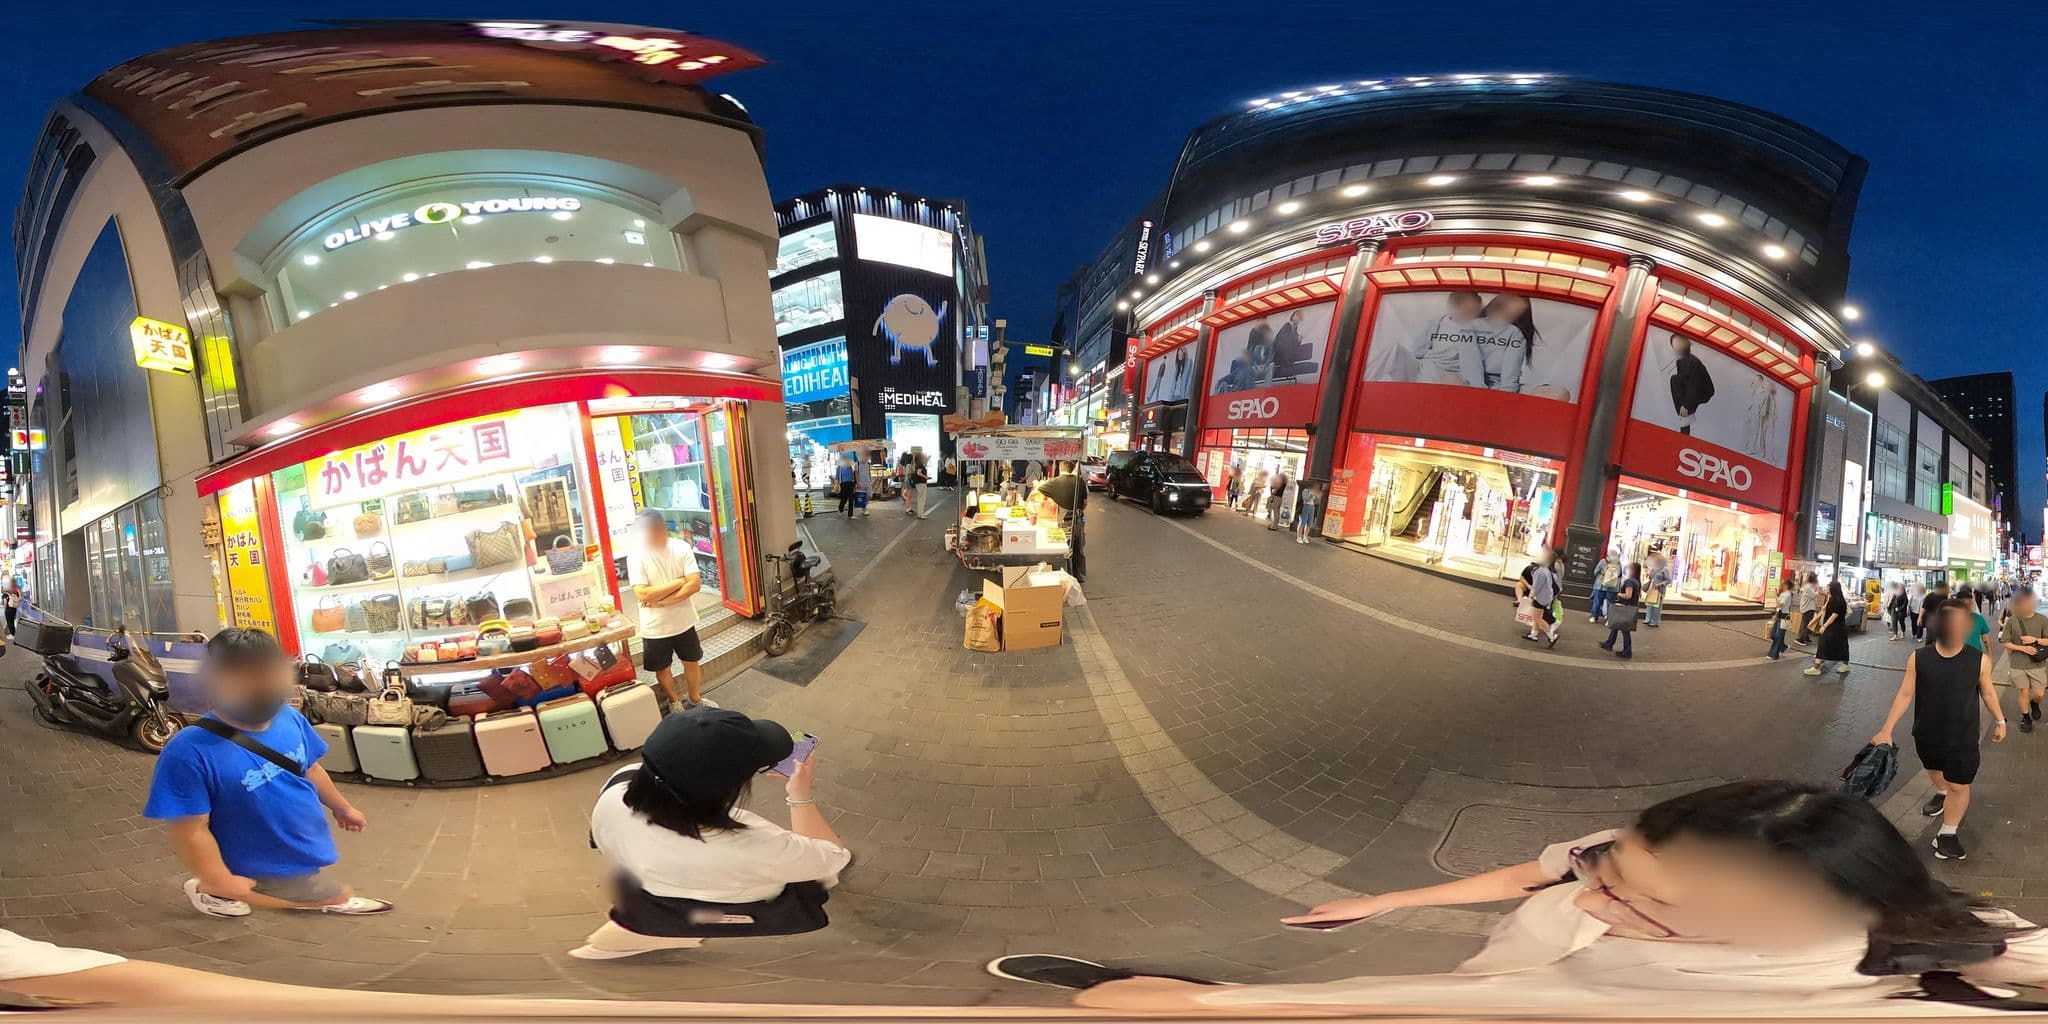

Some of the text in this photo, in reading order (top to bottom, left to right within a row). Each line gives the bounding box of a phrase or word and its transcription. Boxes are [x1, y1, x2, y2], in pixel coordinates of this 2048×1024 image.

[323, 196, 582, 250] OLIVE YOUNG
[1316, 210, 1435, 245] SPAO
[1135, 241, 1149, 275] SKYPARK
[143, 324, 189, 346] かばん
[1430, 333, 1522, 349] FROM BASIC
[151, 339, 187, 360] 天国
[884, 392, 947, 408] MEDIHEAL
[1227, 396, 1279, 420] SPAO
[322, 420, 512, 495] かばん天国
[1677, 448, 1752, 491] SPAO
[227, 531, 257, 549] かばん
[229, 550, 260, 567] 天国
[550, 586, 591, 604] かばん天国
